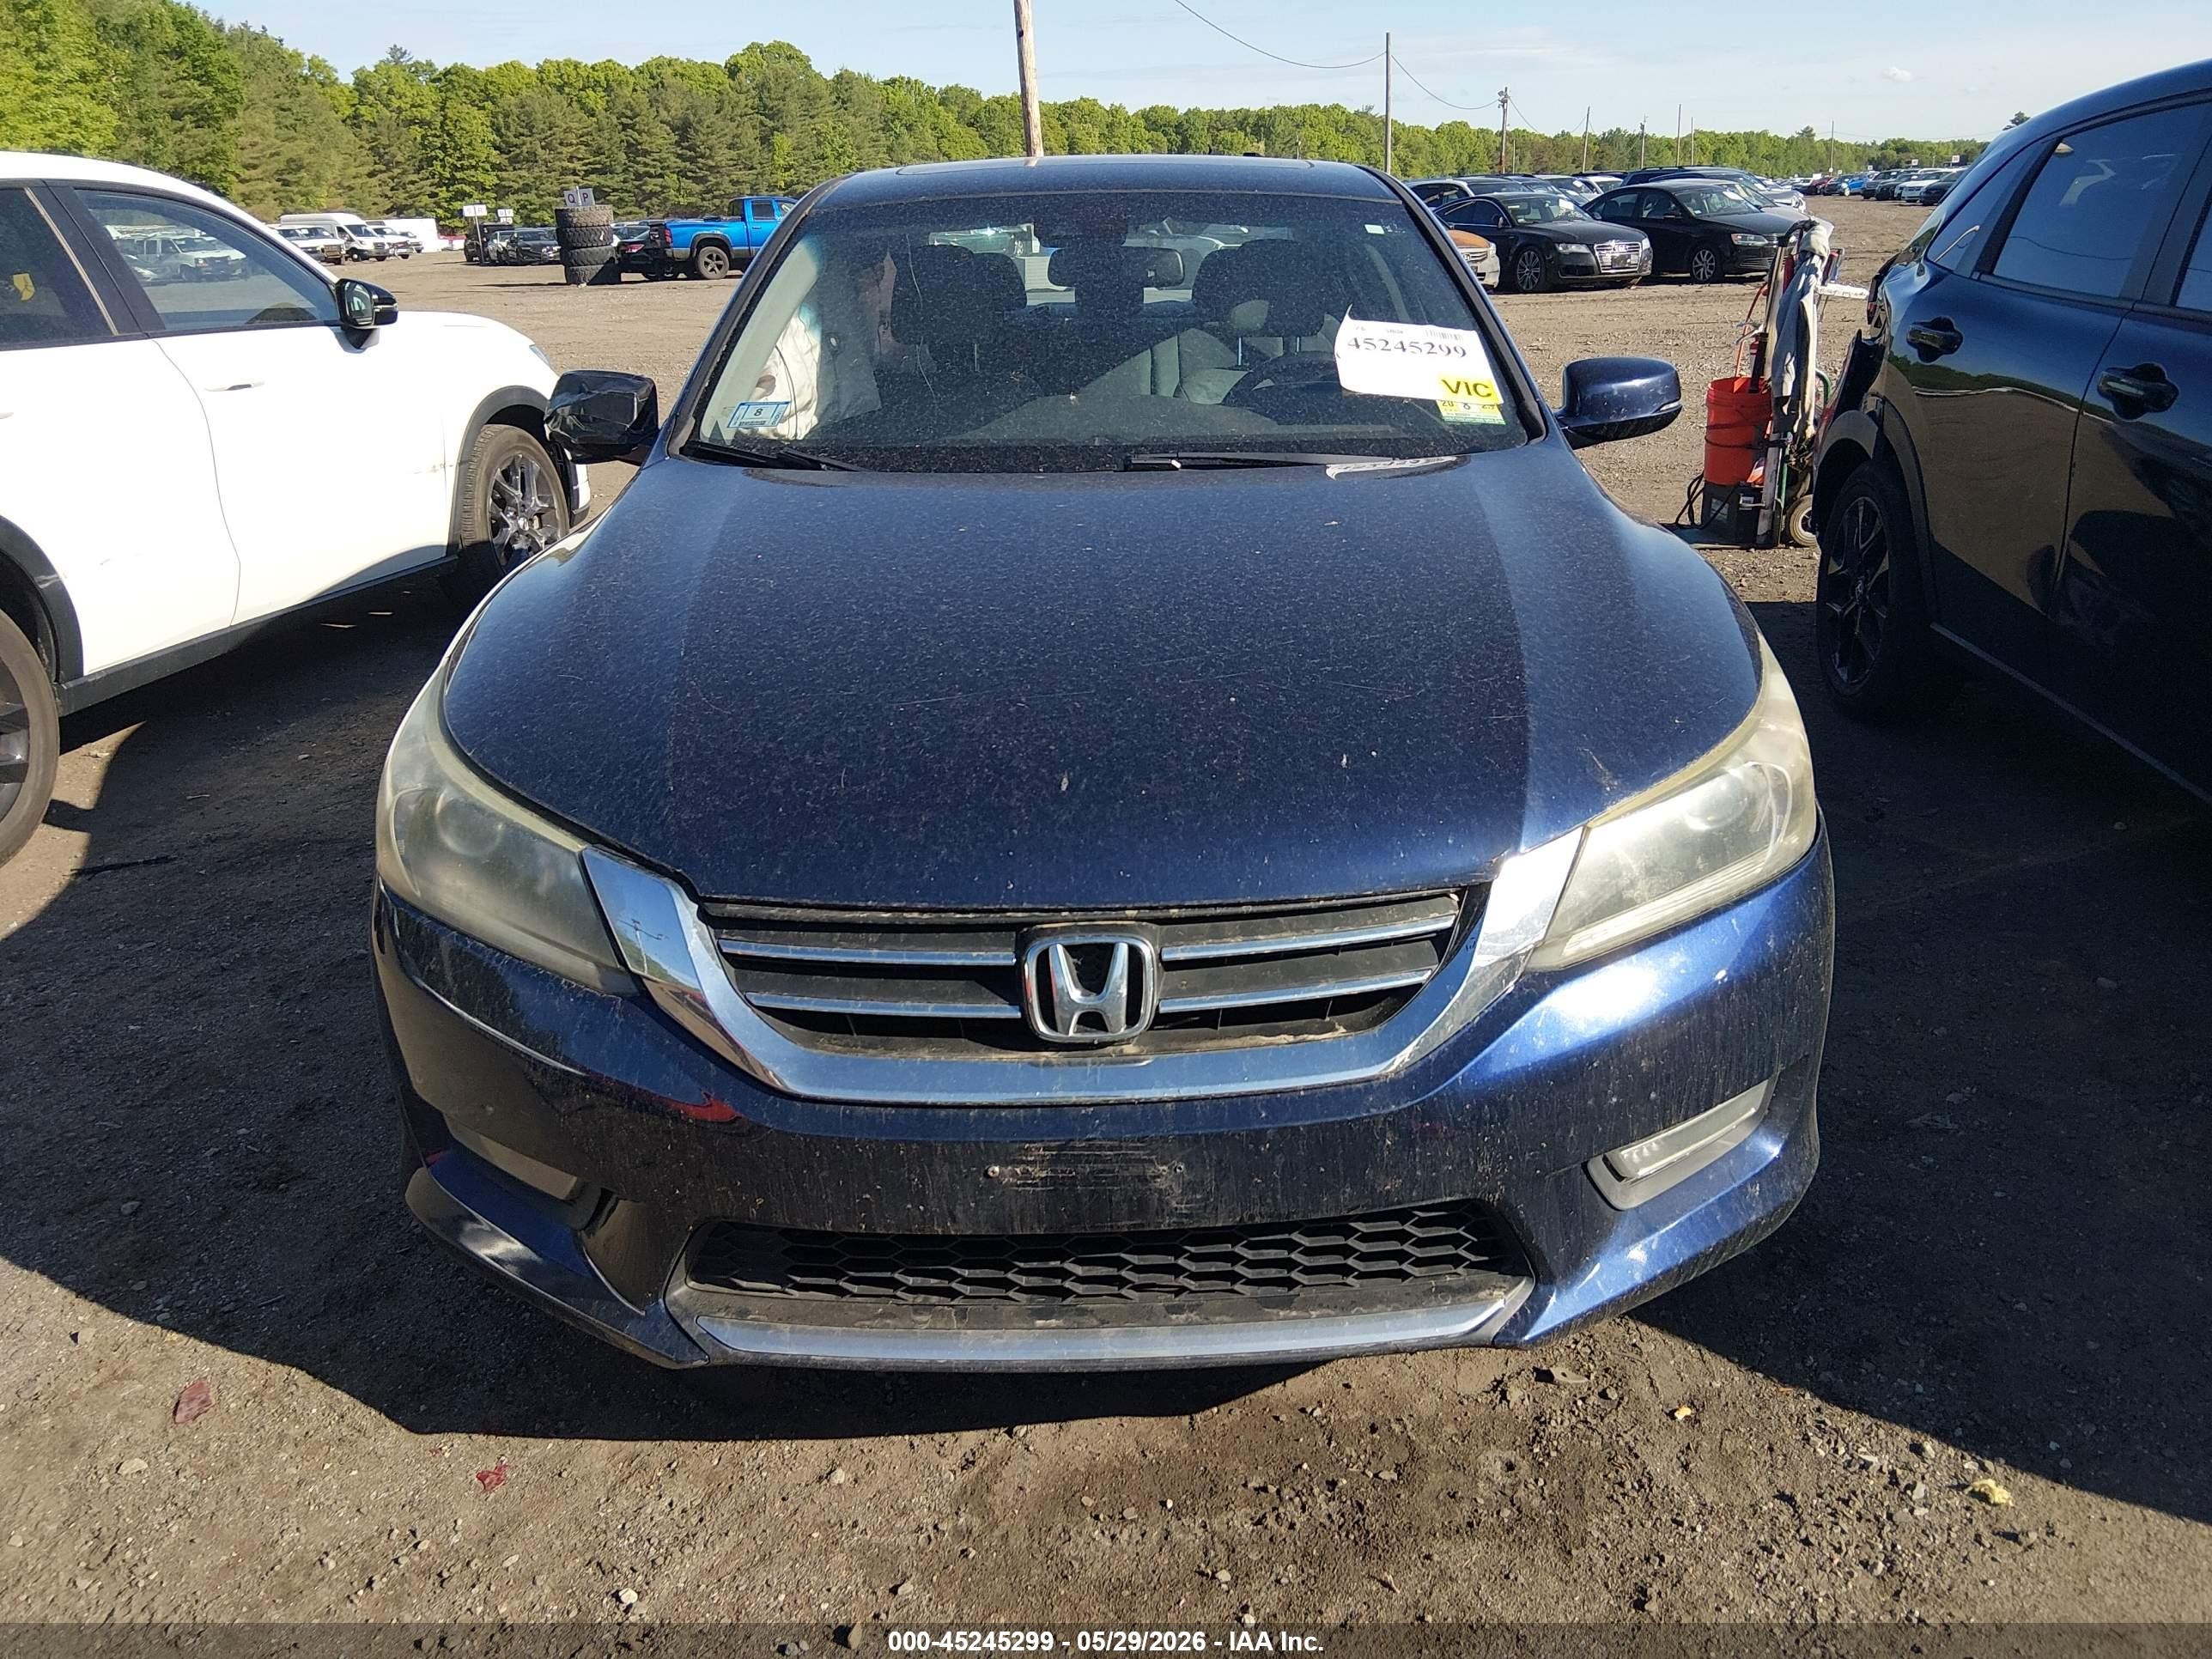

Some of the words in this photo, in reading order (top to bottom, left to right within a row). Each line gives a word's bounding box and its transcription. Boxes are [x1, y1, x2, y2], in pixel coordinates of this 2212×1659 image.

[567, 193, 576, 204] Q
[583, 192, 589, 203] P
[1347, 337, 1467, 358] 45245299
[1441, 379, 1492, 398] VIC
[754, 408, 763, 416] 8
